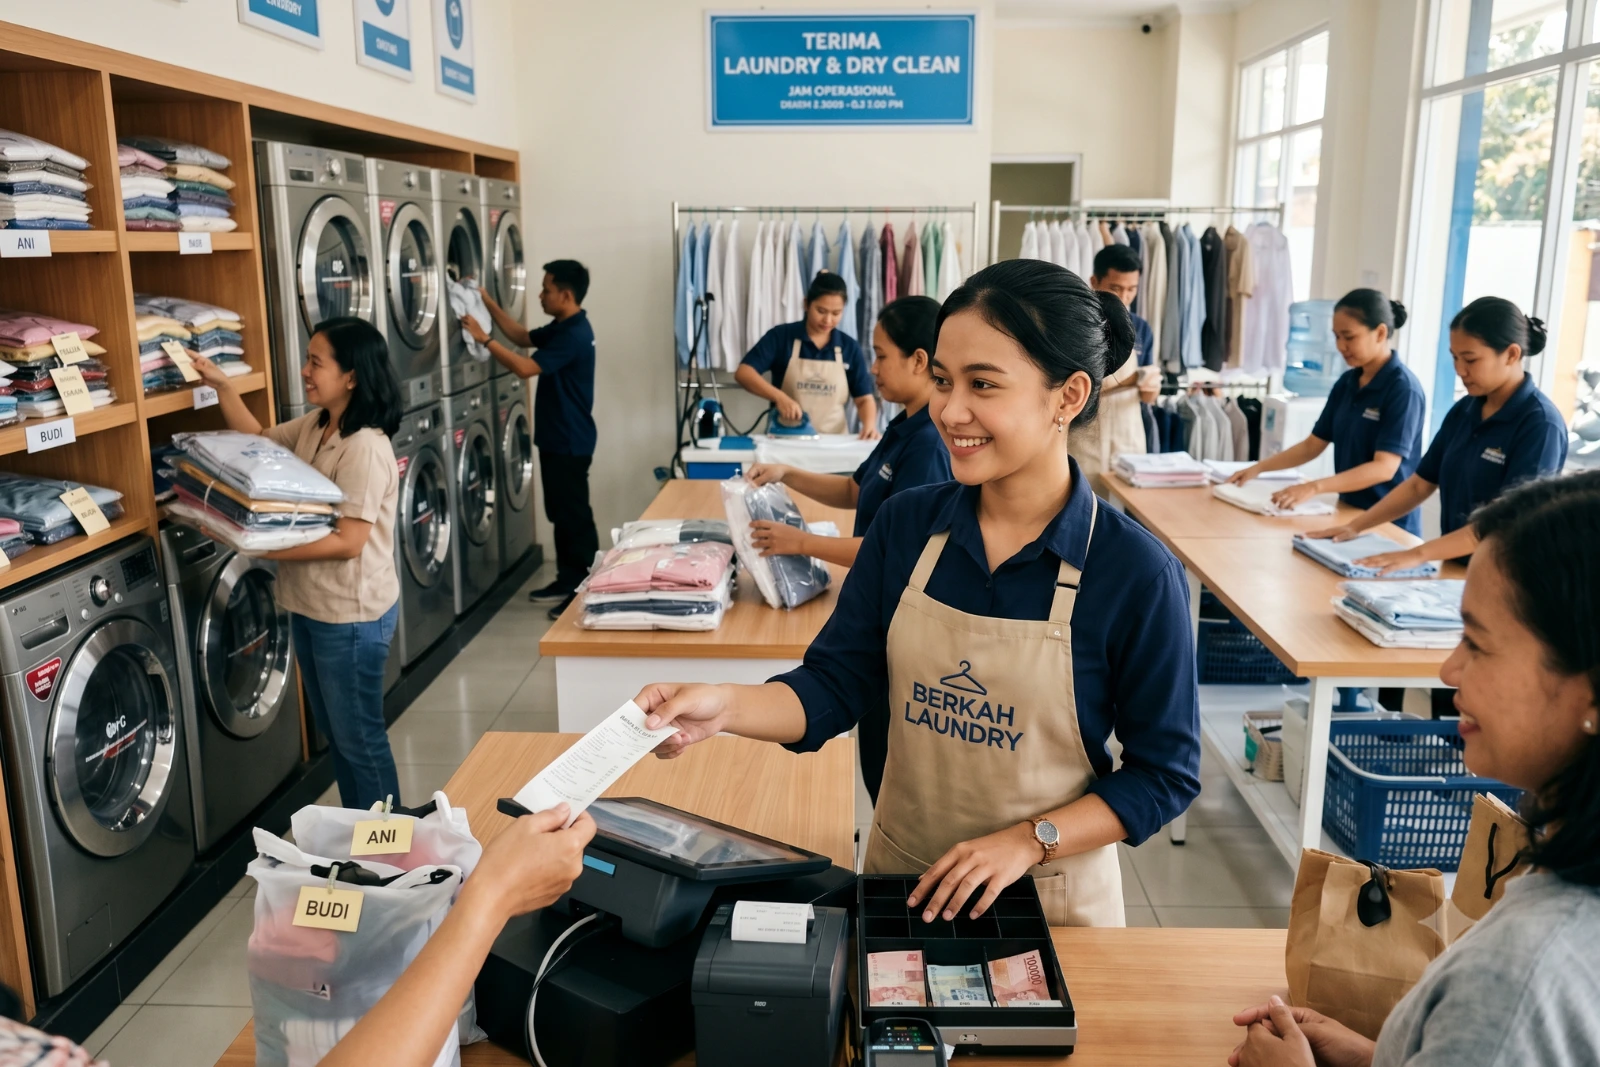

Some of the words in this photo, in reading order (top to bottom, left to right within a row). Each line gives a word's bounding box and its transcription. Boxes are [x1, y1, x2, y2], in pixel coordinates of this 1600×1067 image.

[802, 32, 881, 50] TERIMA
[724, 56, 822, 75] LAUNDRY
[826, 56, 841, 75] &
[847, 56, 888, 74] DRY
[892, 55, 961, 74] CLEAN
[788, 85, 812, 97] JAM
[814, 85, 896, 97] OPERASIONAL
[17, 237, 35, 250] ANI
[40, 427, 63, 443] BUDI
[913, 681, 1014, 727] BERKAH
[905, 701, 1024, 751] LAUNDRY
[367, 829, 396, 845] ANI
[305, 900, 349, 919] BUDI
[1026, 955, 1042, 985] 100000
